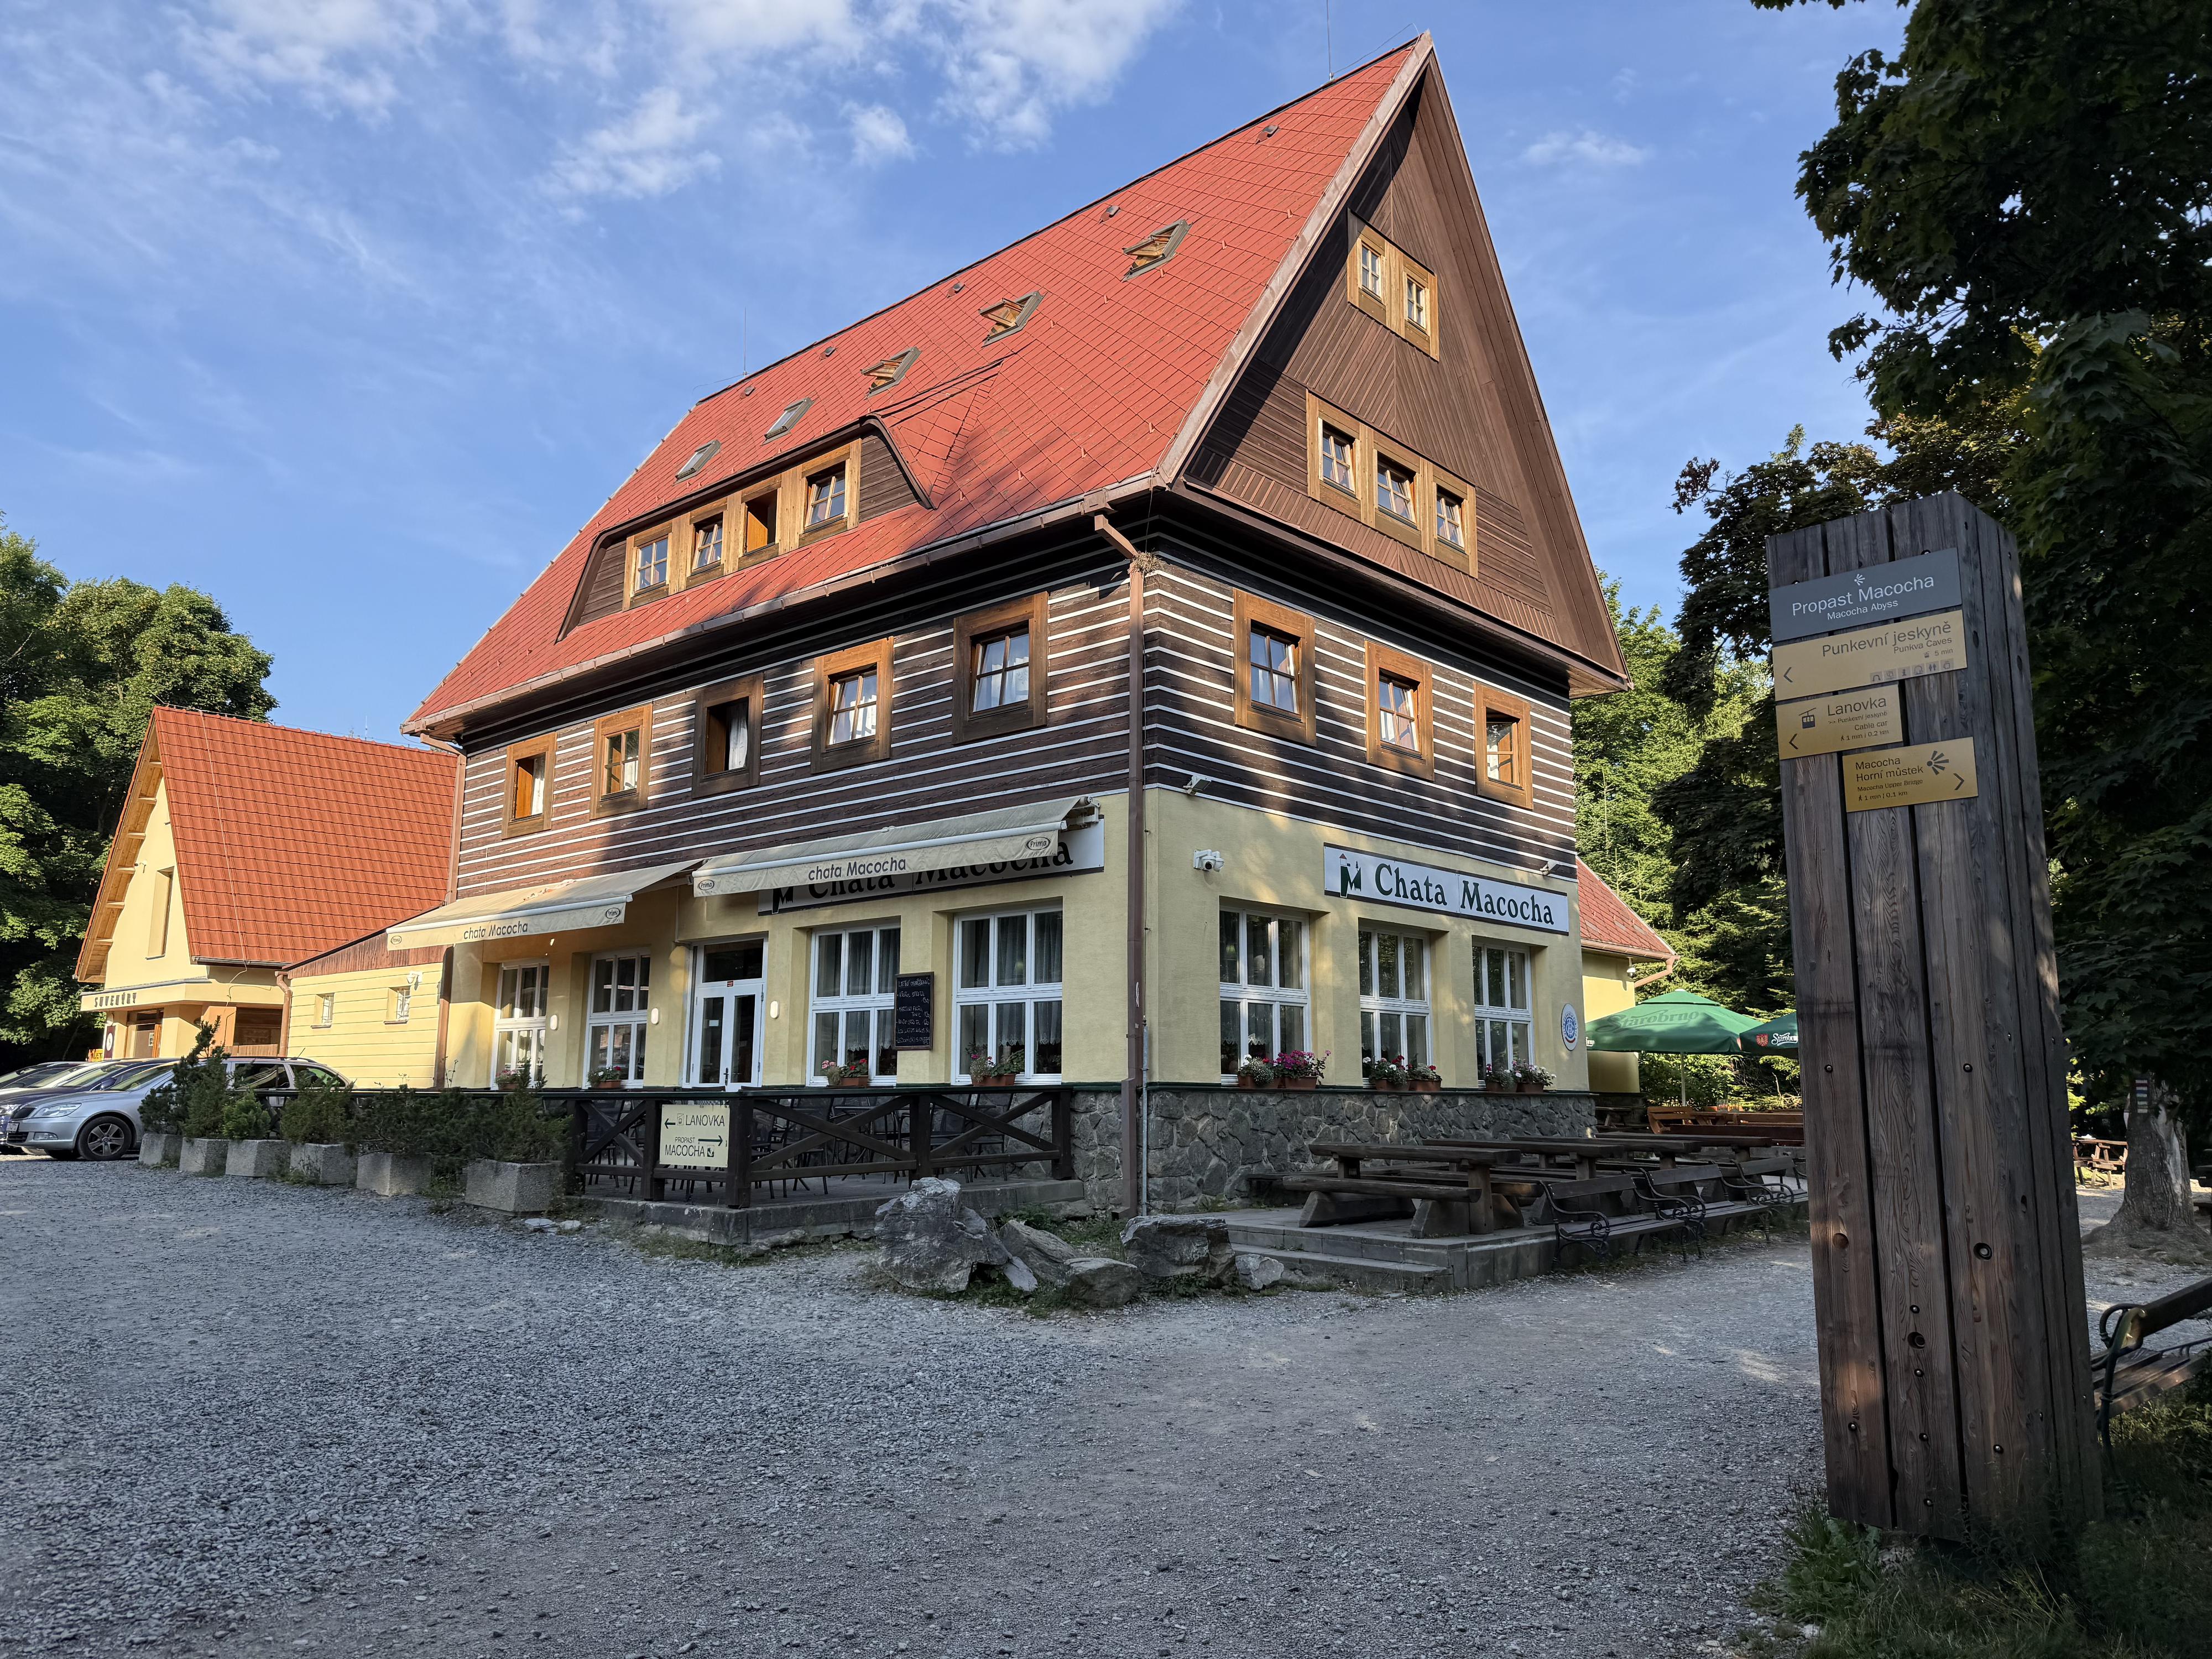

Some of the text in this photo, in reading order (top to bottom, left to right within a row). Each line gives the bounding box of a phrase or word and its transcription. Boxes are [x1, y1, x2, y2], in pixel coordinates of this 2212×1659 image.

[1792, 577, 1934, 616] Propast Macocha
[1827, 600, 1898, 619] Macocha Abyss
[1823, 621, 1951, 656] Punkevní jeskyně
[1893, 637, 1952, 654] Punkva Caves
[1828, 697, 1886, 716] Lanovka
[1854, 722, 1875, 731] Cable
[1856, 758, 1900, 770] Macocha
[1856, 765, 1924, 782] Horní můstek
[808, 857, 906, 881] chata Macocha
[1375, 863, 1448, 906] Chata
[1460, 880, 1554, 925] Macocha
[463, 921, 528, 940] chata Macocha
[95, 993, 137, 1008] SUVENÝRY
[1595, 1009, 1699, 1033] Starobrno
[686, 1114, 724, 1126] LANOVKA
[665, 1144, 705, 1157] MACOCHA
